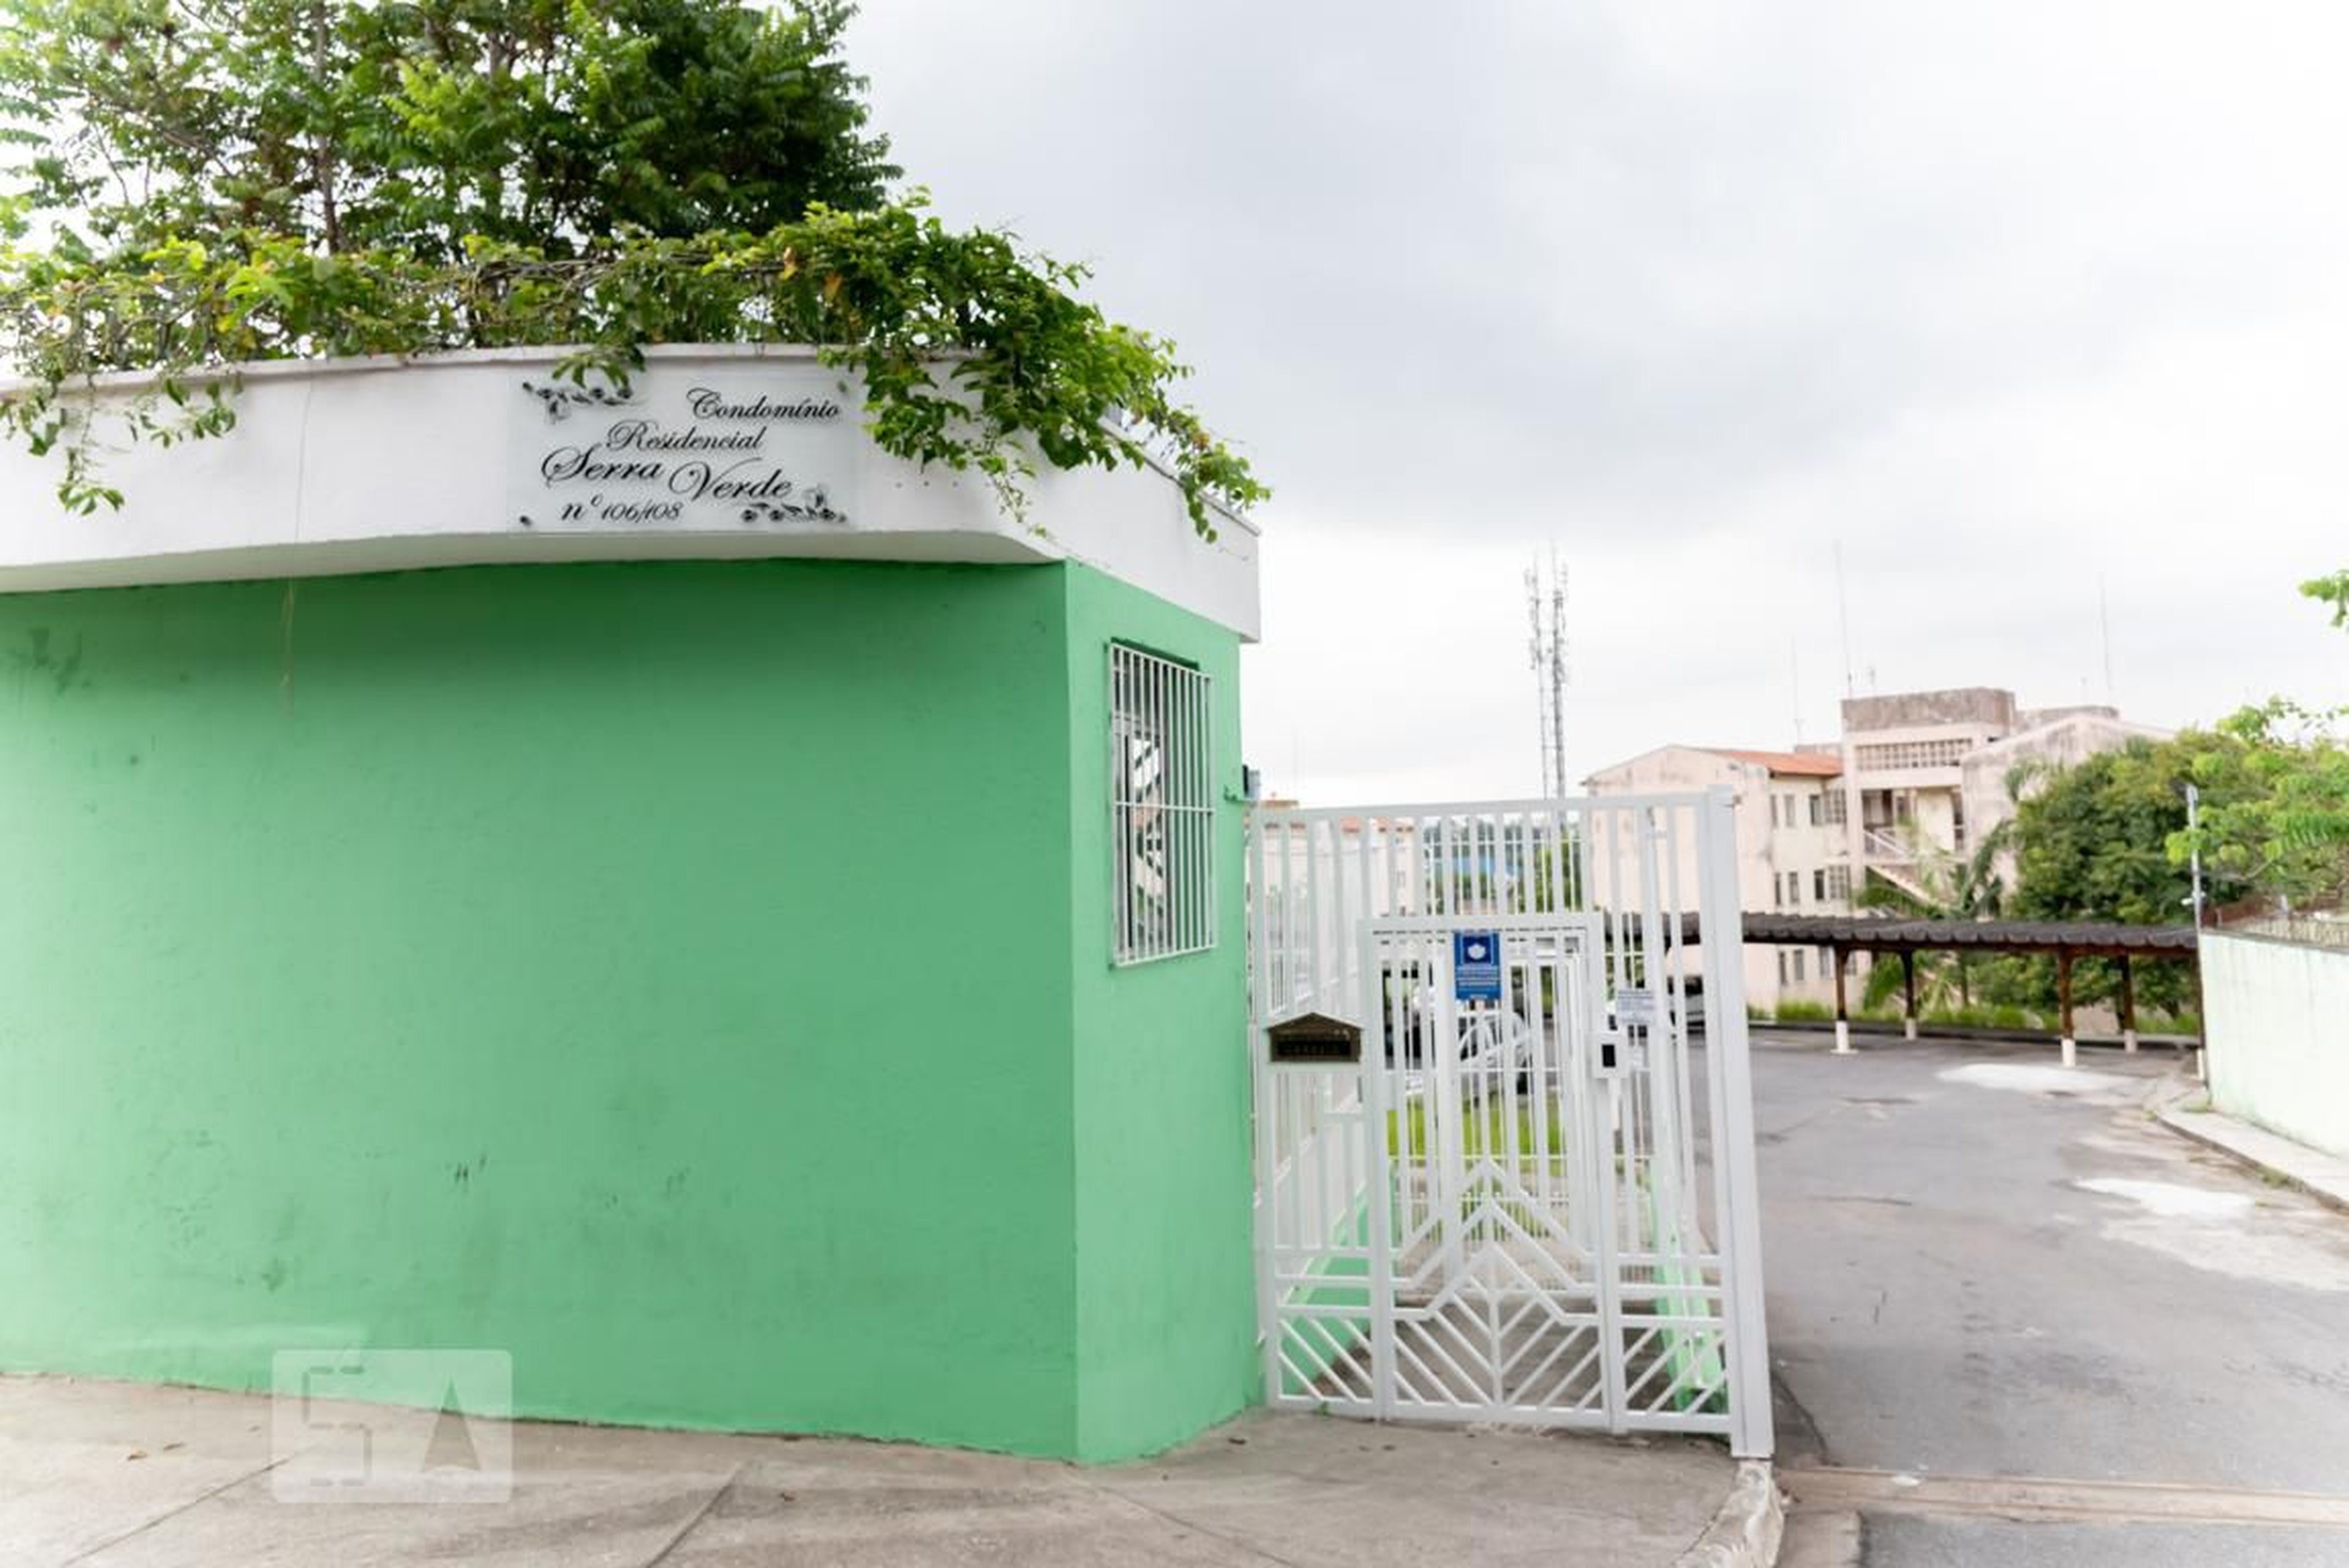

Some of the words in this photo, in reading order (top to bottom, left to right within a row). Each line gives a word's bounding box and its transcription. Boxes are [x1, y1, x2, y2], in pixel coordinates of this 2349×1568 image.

[686, 387, 841, 420] Condomínio
[606, 420, 767, 451] Residencial
[541, 443, 662, 488] Serra
[668, 457, 793, 501] Verde
[602, 499, 683, 523] 106/108
